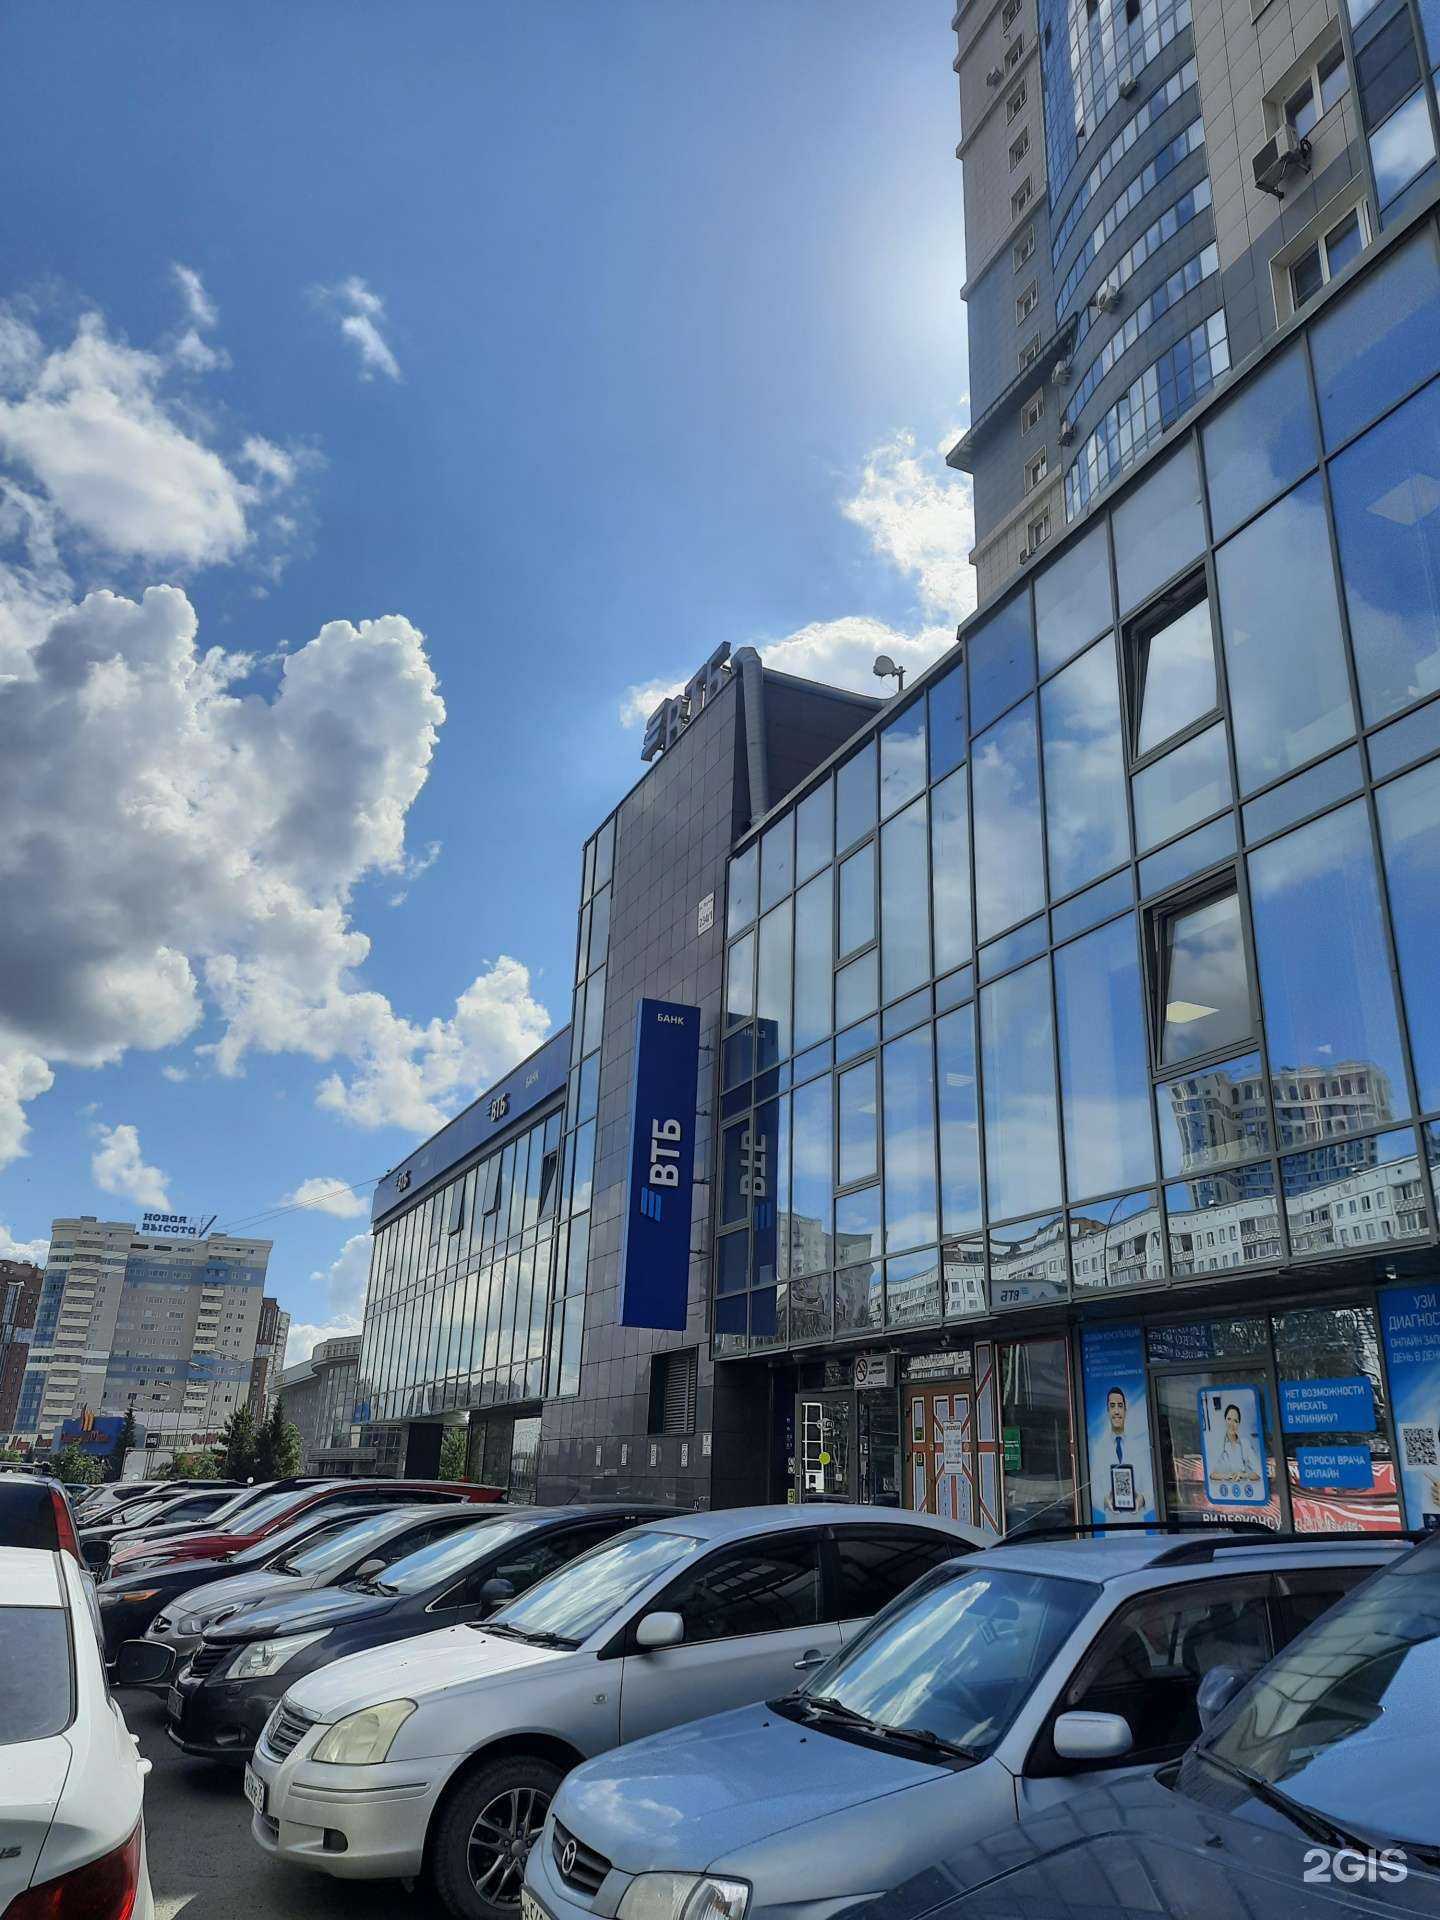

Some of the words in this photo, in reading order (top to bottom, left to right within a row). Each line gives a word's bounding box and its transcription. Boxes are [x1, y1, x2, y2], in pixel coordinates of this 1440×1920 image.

[657, 1013, 685, 1025] БАНК
[490, 1093, 509, 1121] ВТБ
[649, 1118, 682, 1187] ВТБ
[1413, 1295, 1436, 1309] УЗИ
[1390, 1335, 1422, 1348] ОНЛАЙН
[1392, 1352, 1415, 1363] ДЕНЬ
[1285, 1389, 1299, 1399] НЕТ
[1301, 1385, 1365, 1398] ВОЗМОЖНОСТИ
[1286, 1401, 1328, 1411] ПРИЕХАТЬ
[1288, 1415, 1294, 1424] В
[1295, 1413, 1338, 1424] КЛИНИКУ?
[1303, 1455, 1336, 1466] СПРОСИ
[1337, 1454, 1366, 1465] ВРАЧА
[1305, 1468, 1340, 1479] ОНЛАЙН
